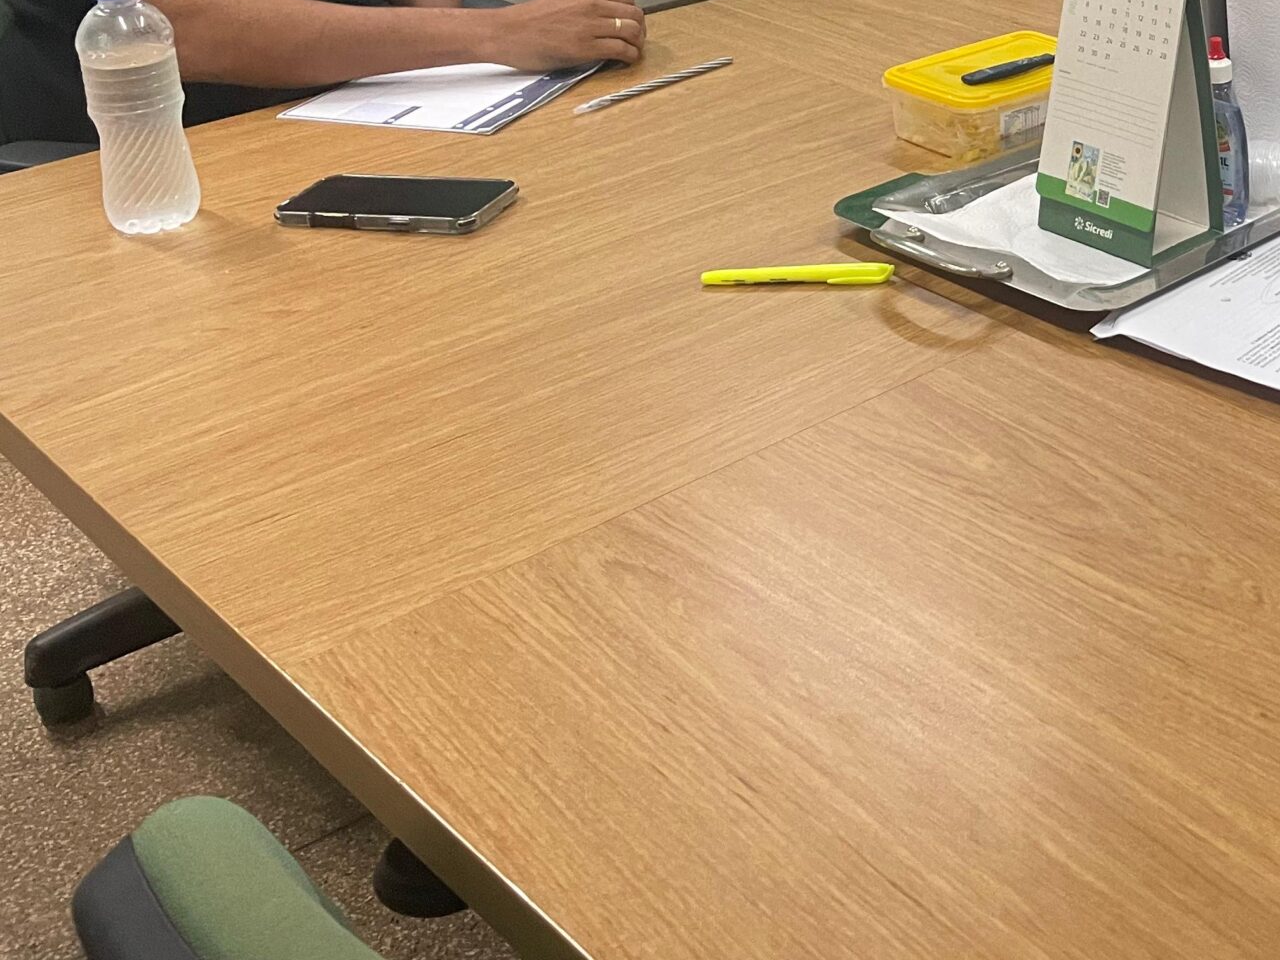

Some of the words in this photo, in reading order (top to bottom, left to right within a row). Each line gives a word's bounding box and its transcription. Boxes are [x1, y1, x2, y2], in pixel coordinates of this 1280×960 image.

[1138, 14, 1144, 22] 12
[1152, 18, 1157, 26] 13
[1109, 22, 1115, 30] 17
[1122, 26, 1128, 34] 18
[1149, 33, 1156, 41] 20
[1078, 45, 1085, 53] 29
[1091, 49, 1098, 57] 30
[1093, 33, 1100, 41] 23
[1106, 37, 1113, 45] 24
[1120, 41, 1126, 49] 25
[1146, 48, 1153, 56] 27
[1160, 52, 1167, 60] 28
[1085, 221, 1114, 239] Sicredi
